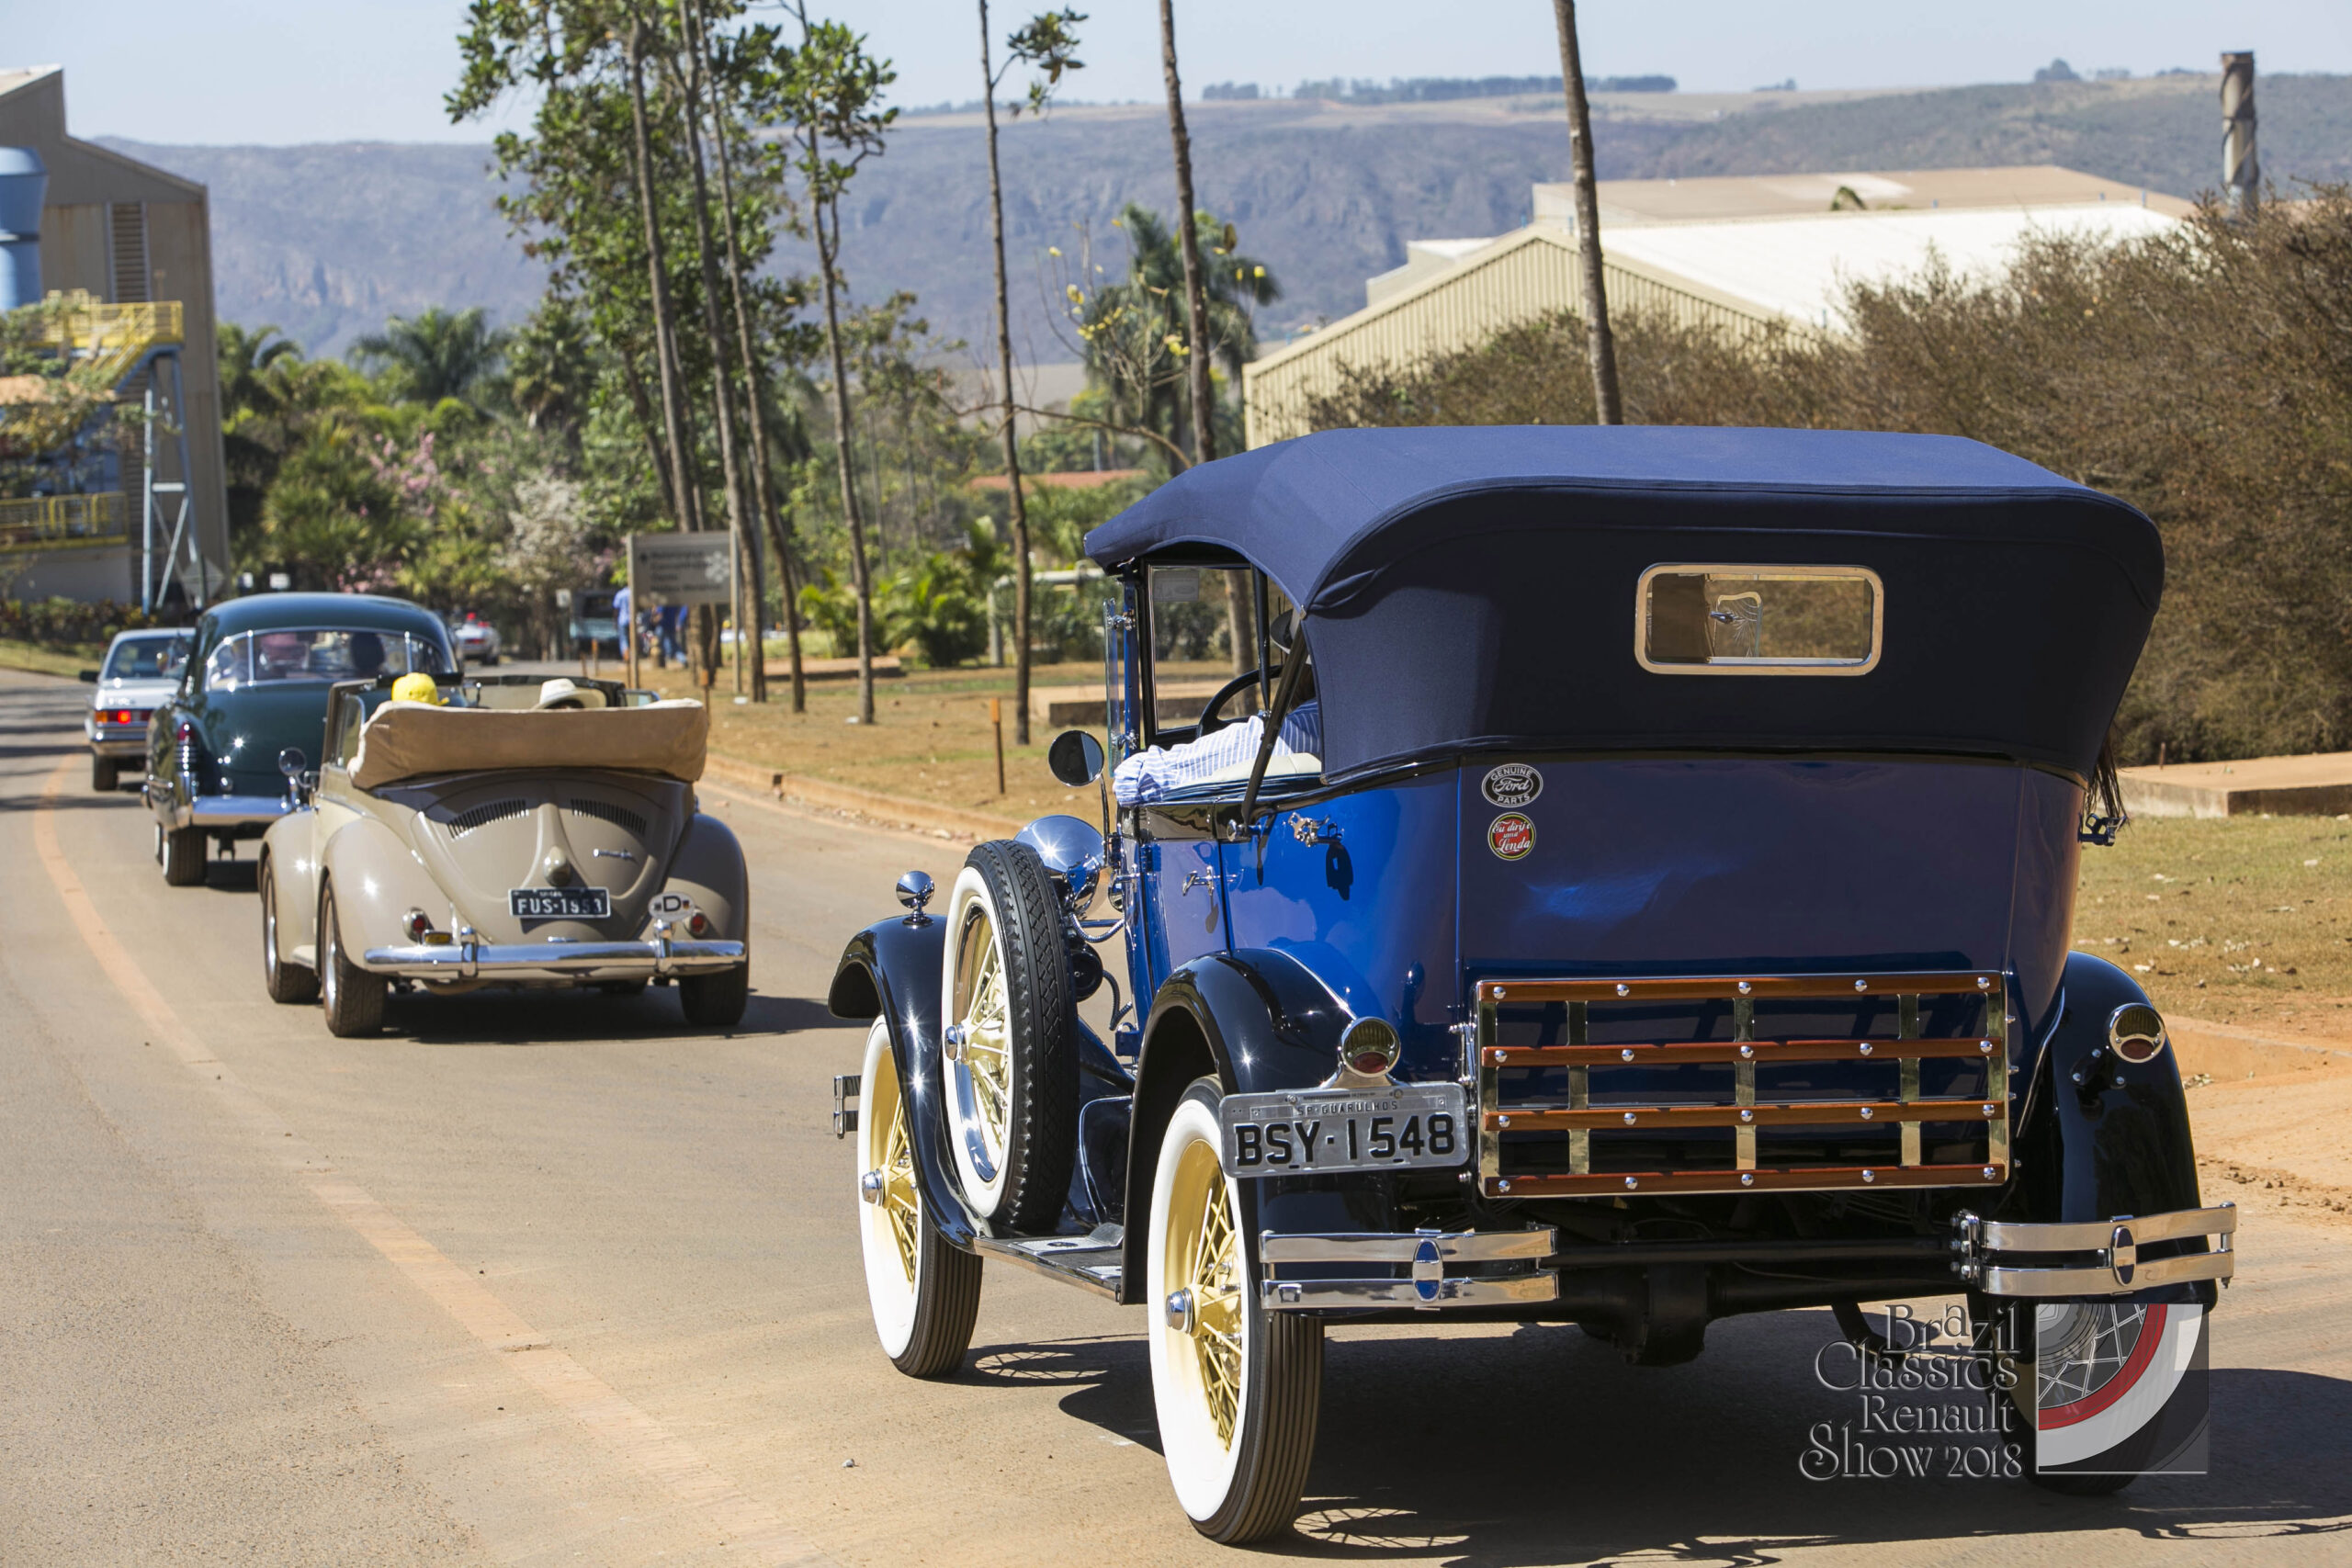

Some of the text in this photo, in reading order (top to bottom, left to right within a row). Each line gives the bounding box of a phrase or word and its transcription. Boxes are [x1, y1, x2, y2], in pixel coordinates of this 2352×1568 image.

[1490, 767, 1532, 781] GENUINE
[1495, 777, 1530, 792] Ford
[1498, 794, 1530, 805] PARTS
[1492, 821, 1510, 833] Eu
[662, 895, 681, 912] D
[1233, 1112, 1455, 1167] BSY-1548
